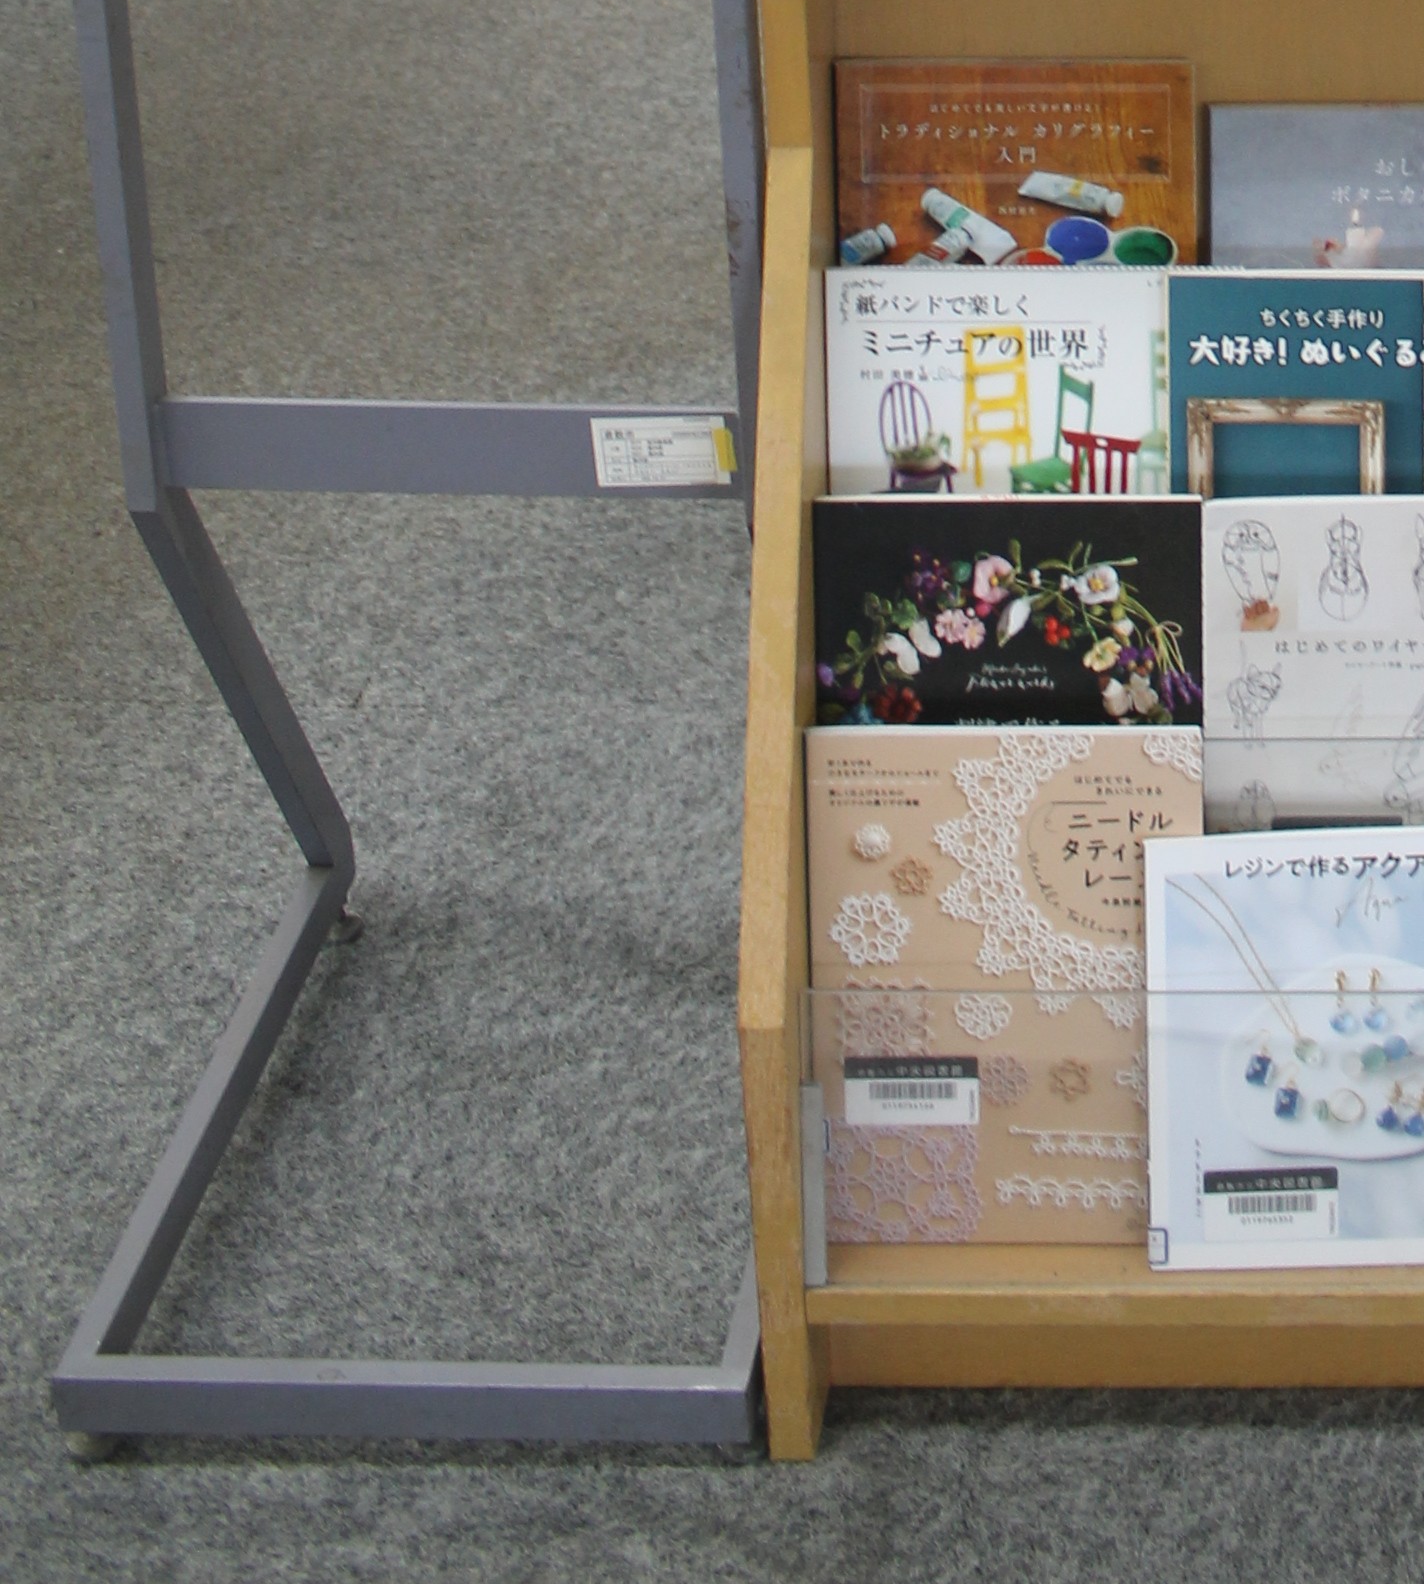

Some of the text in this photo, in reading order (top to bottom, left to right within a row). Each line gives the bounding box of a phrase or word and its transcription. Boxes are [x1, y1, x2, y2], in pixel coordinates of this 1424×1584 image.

[878, 122, 1156, 140] トラディショナル カリグラフィー
[997, 145, 1038, 165] 入門
[855, 294, 1030, 317] 紙バンドで楽しく
[860, 327, 1089, 360] ミニチュアの世界
[1187, 334, 1289, 368] 大好き!
[1067, 808, 1174, 833] ニードル
[1084, 868, 1143, 889] レー
